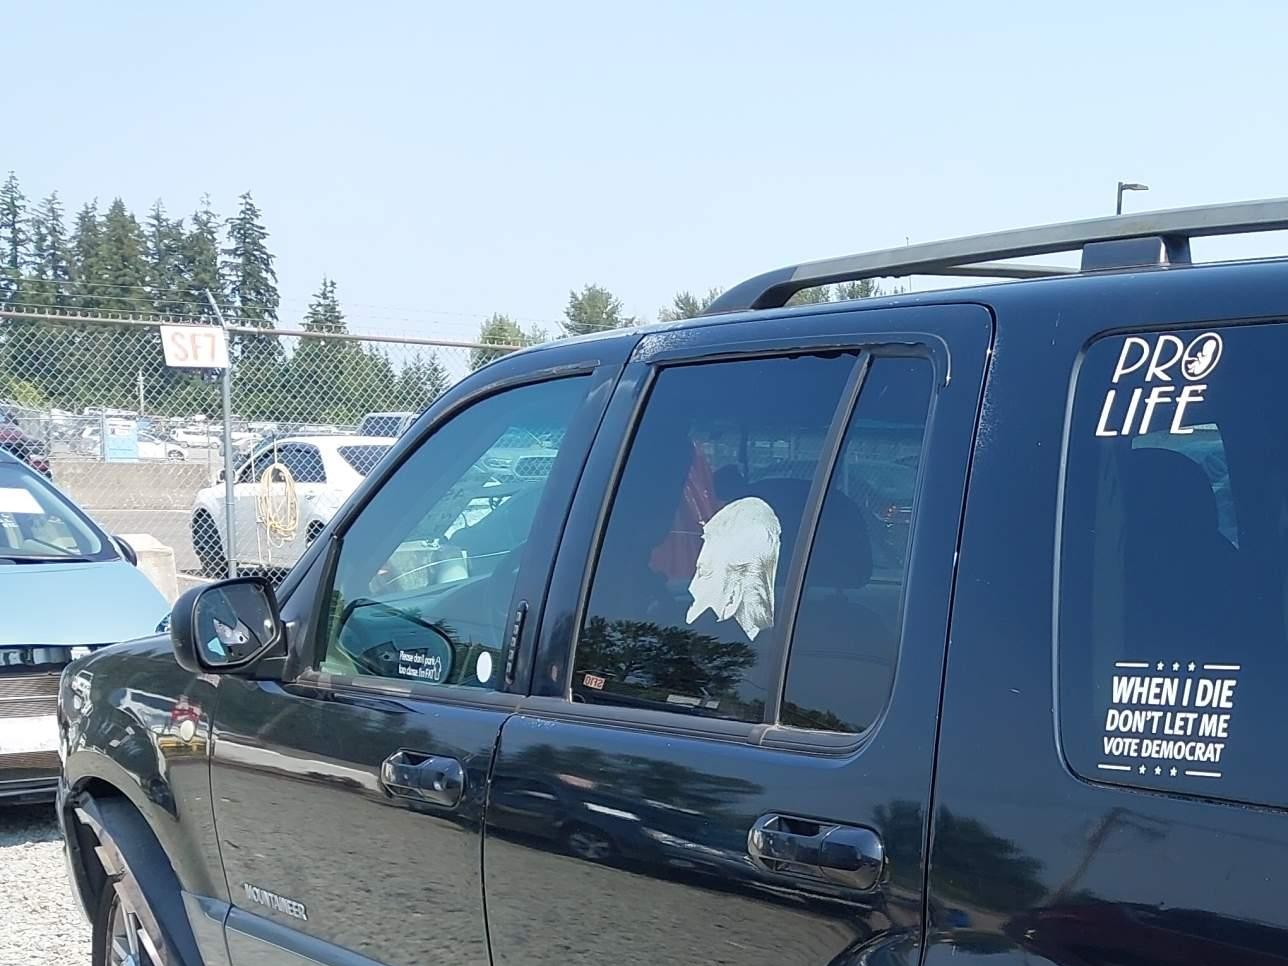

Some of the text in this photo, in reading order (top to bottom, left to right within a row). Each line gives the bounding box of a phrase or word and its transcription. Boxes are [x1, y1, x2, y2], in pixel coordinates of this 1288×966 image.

[1111, 332, 1223, 383] PRO
[1095, 384, 1208, 436] LIFE
[1112, 676, 1237, 708] WHEN I DIE
[1105, 709, 1231, 738] DON'T LET ME
[1103, 736, 1225, 762] VOTE DEMOCRAT
